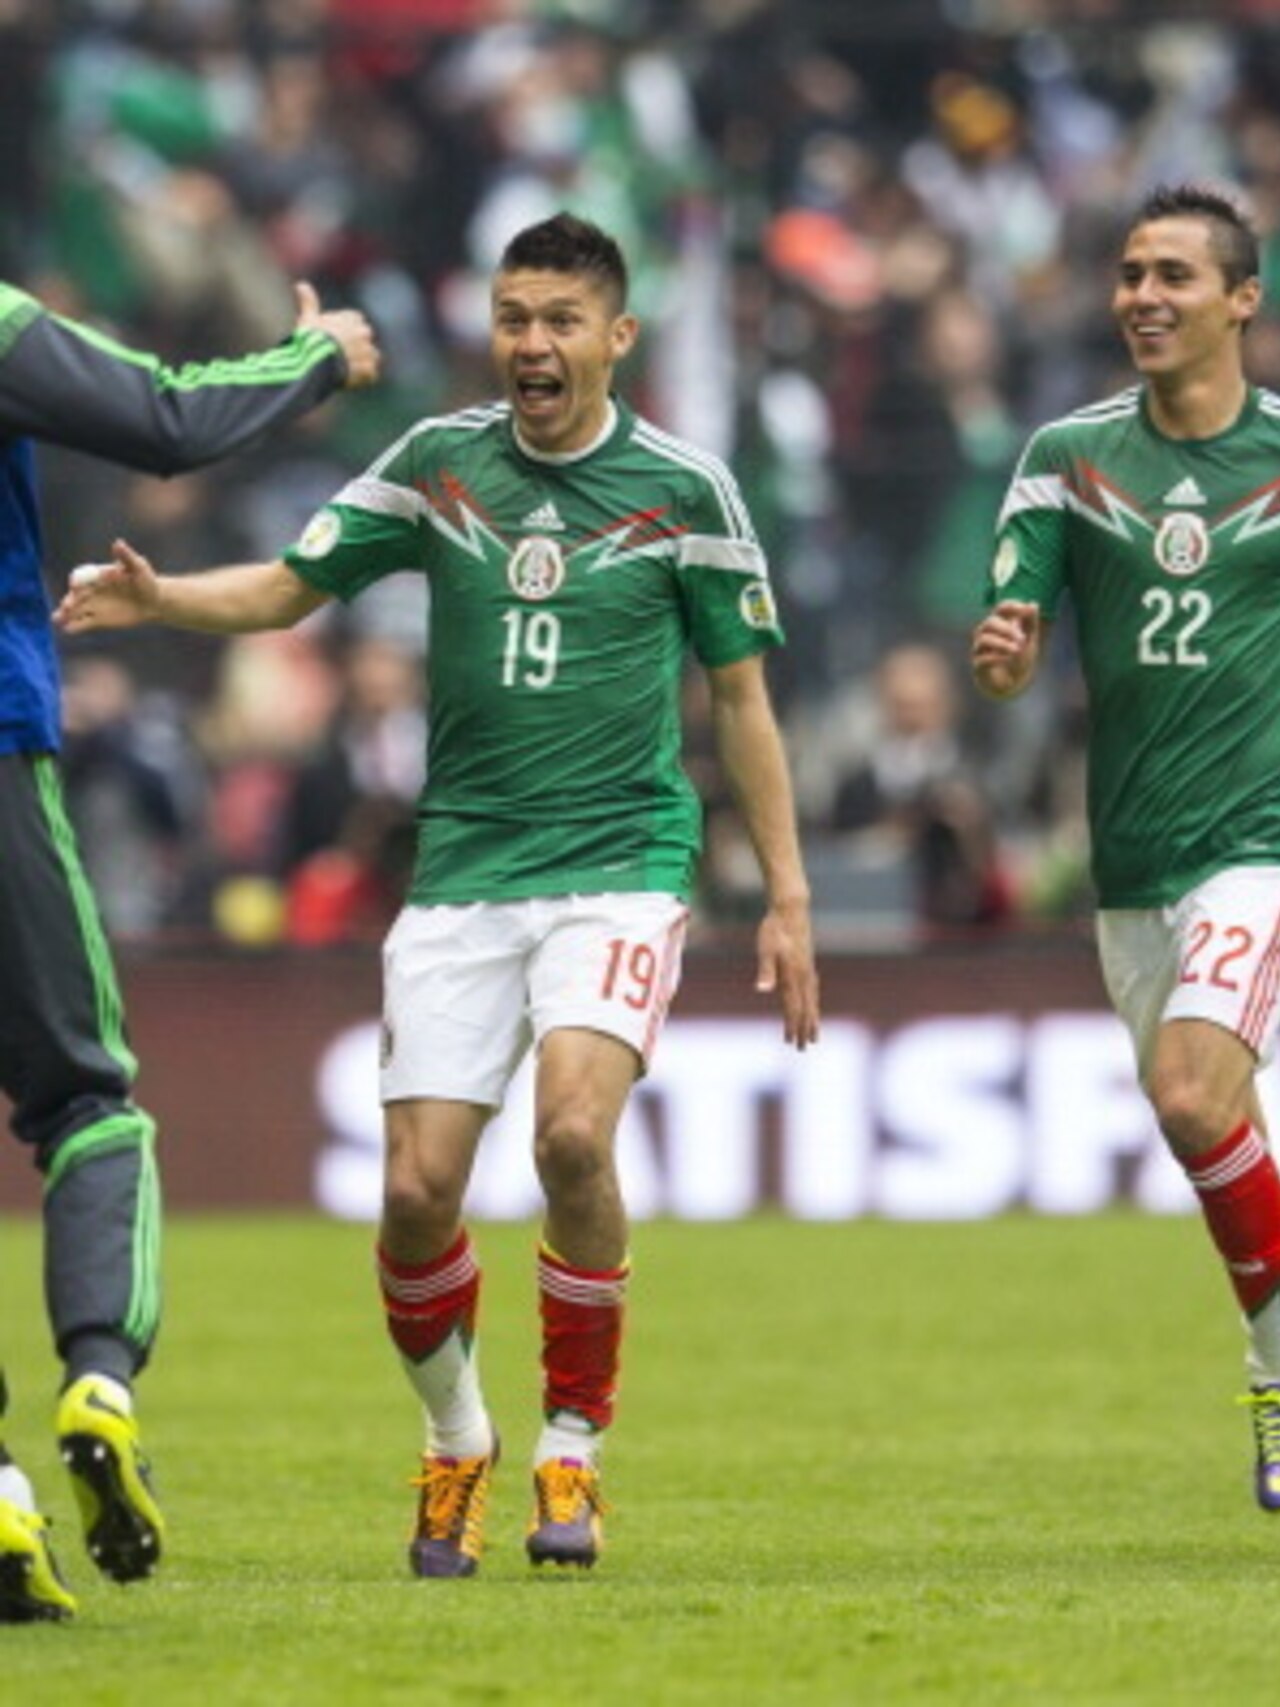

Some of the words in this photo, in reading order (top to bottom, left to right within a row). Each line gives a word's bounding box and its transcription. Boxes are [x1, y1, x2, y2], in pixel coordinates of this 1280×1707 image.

[501, 609, 561, 689] 19
[1138, 586, 1212, 665] 22
[602, 938, 656, 1010] 19
[1179, 920, 1254, 991] 22
